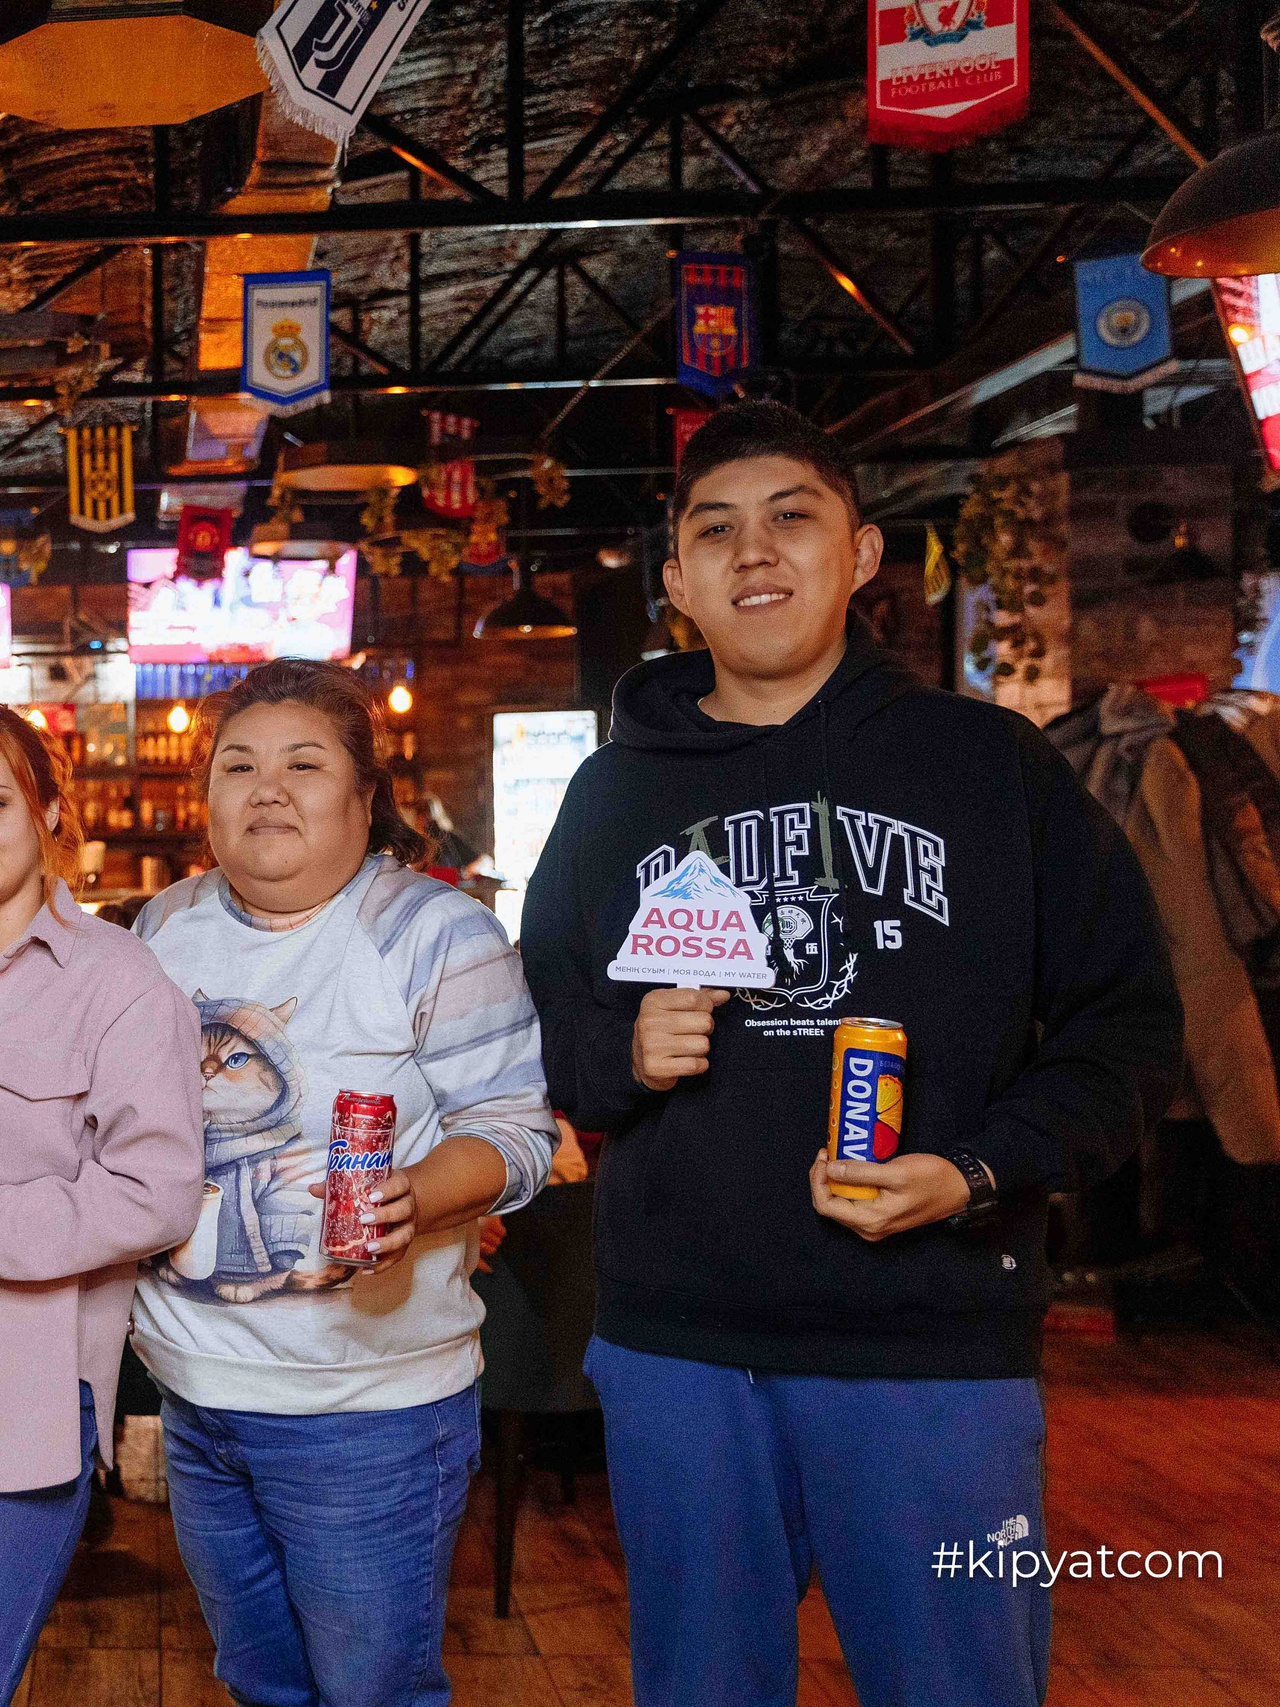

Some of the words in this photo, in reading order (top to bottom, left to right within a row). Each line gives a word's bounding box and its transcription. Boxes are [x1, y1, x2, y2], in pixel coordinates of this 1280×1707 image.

[891, 52, 1001, 86] LIVERPOOL
[891, 79, 960, 98] FOOTBALL
[965, 70, 1002, 86] CLUB
[641, 907, 747, 932] AQUA
[630, 934, 754, 960] ROSSA
[873, 920, 902, 949] 15
[692, 970, 717, 978] ВОДА
[744, 1018, 789, 1027] Obsession
[790, 1017, 815, 1026] beats
[816, 1018, 842, 1026] talent
[776, 1028, 791, 1036] the
[792, 1028, 825, 1036] sTREEt
